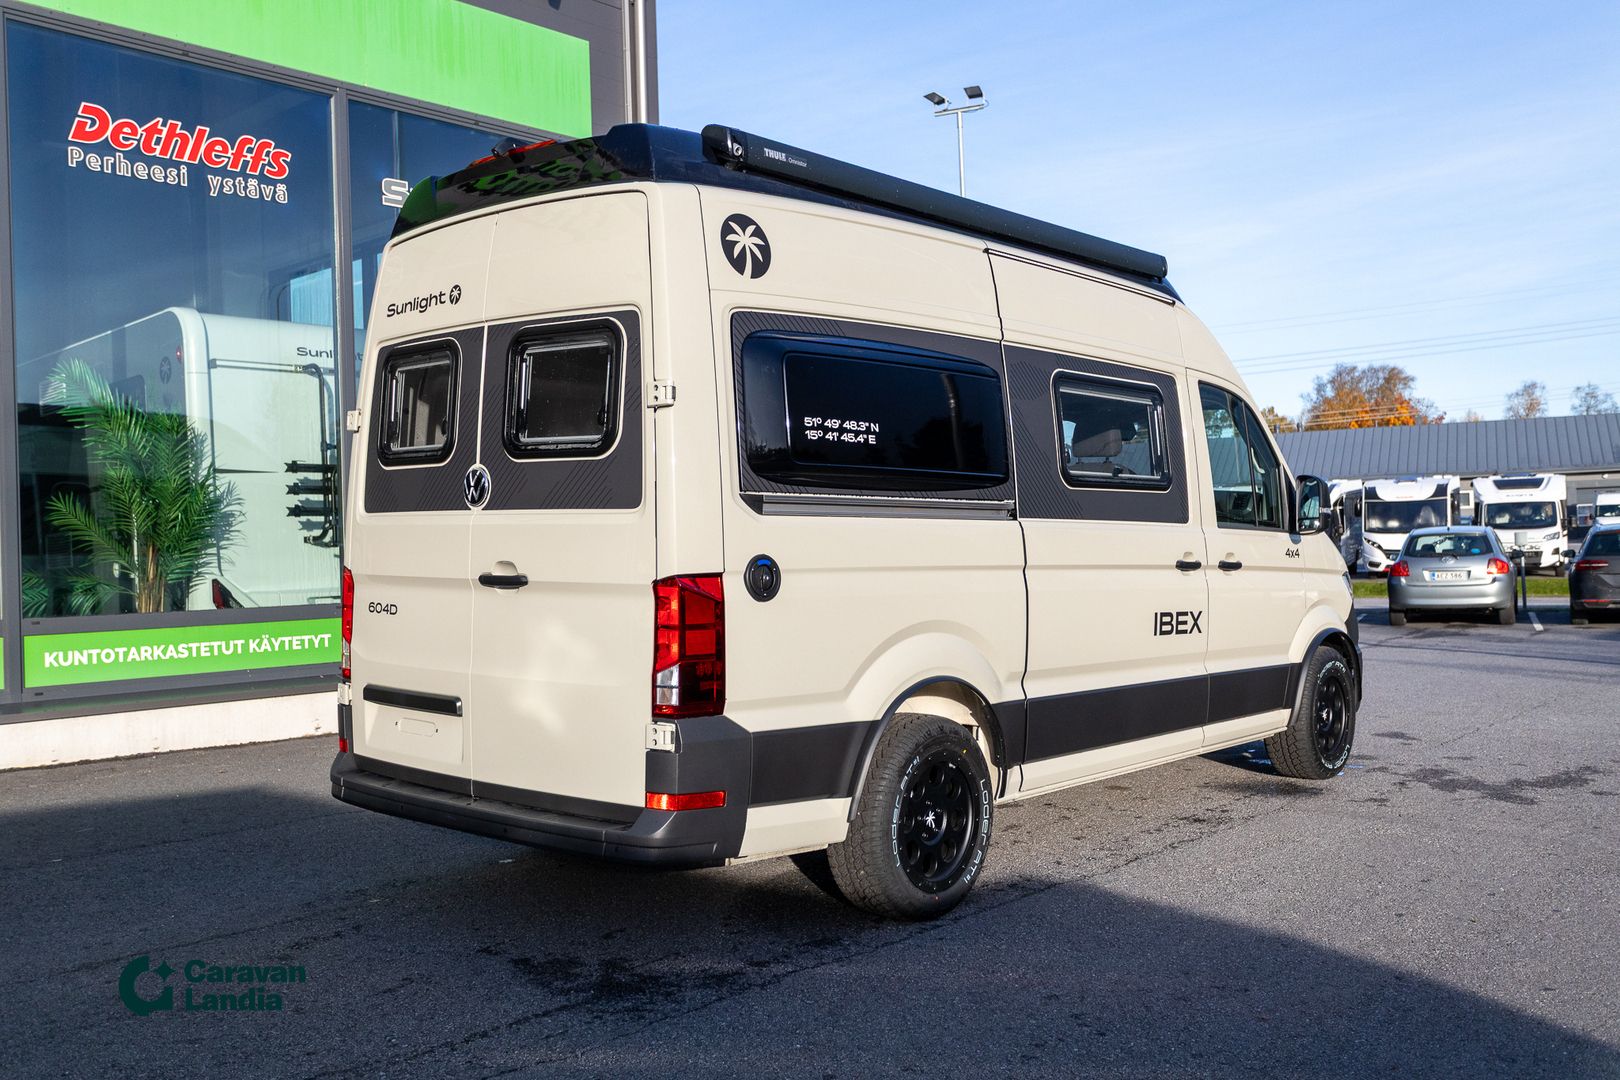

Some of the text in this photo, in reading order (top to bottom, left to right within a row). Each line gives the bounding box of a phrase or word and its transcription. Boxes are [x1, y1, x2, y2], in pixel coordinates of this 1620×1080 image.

[68, 101, 292, 180] Dethleffs
[764, 147, 786, 162] THULE
[67, 146, 288, 203] Perheesi ystävä
[386, 290, 446, 318] Sunlight
[870, 422, 880, 433] N
[868, 434, 877, 445] E
[1285, 548, 1300, 559] 4x4
[368, 602, 398, 615] 604D
[1153, 610, 1203, 637] IBEX
[44, 633, 332, 668] KUNTOTARKASTETUT KÄYTETYT
